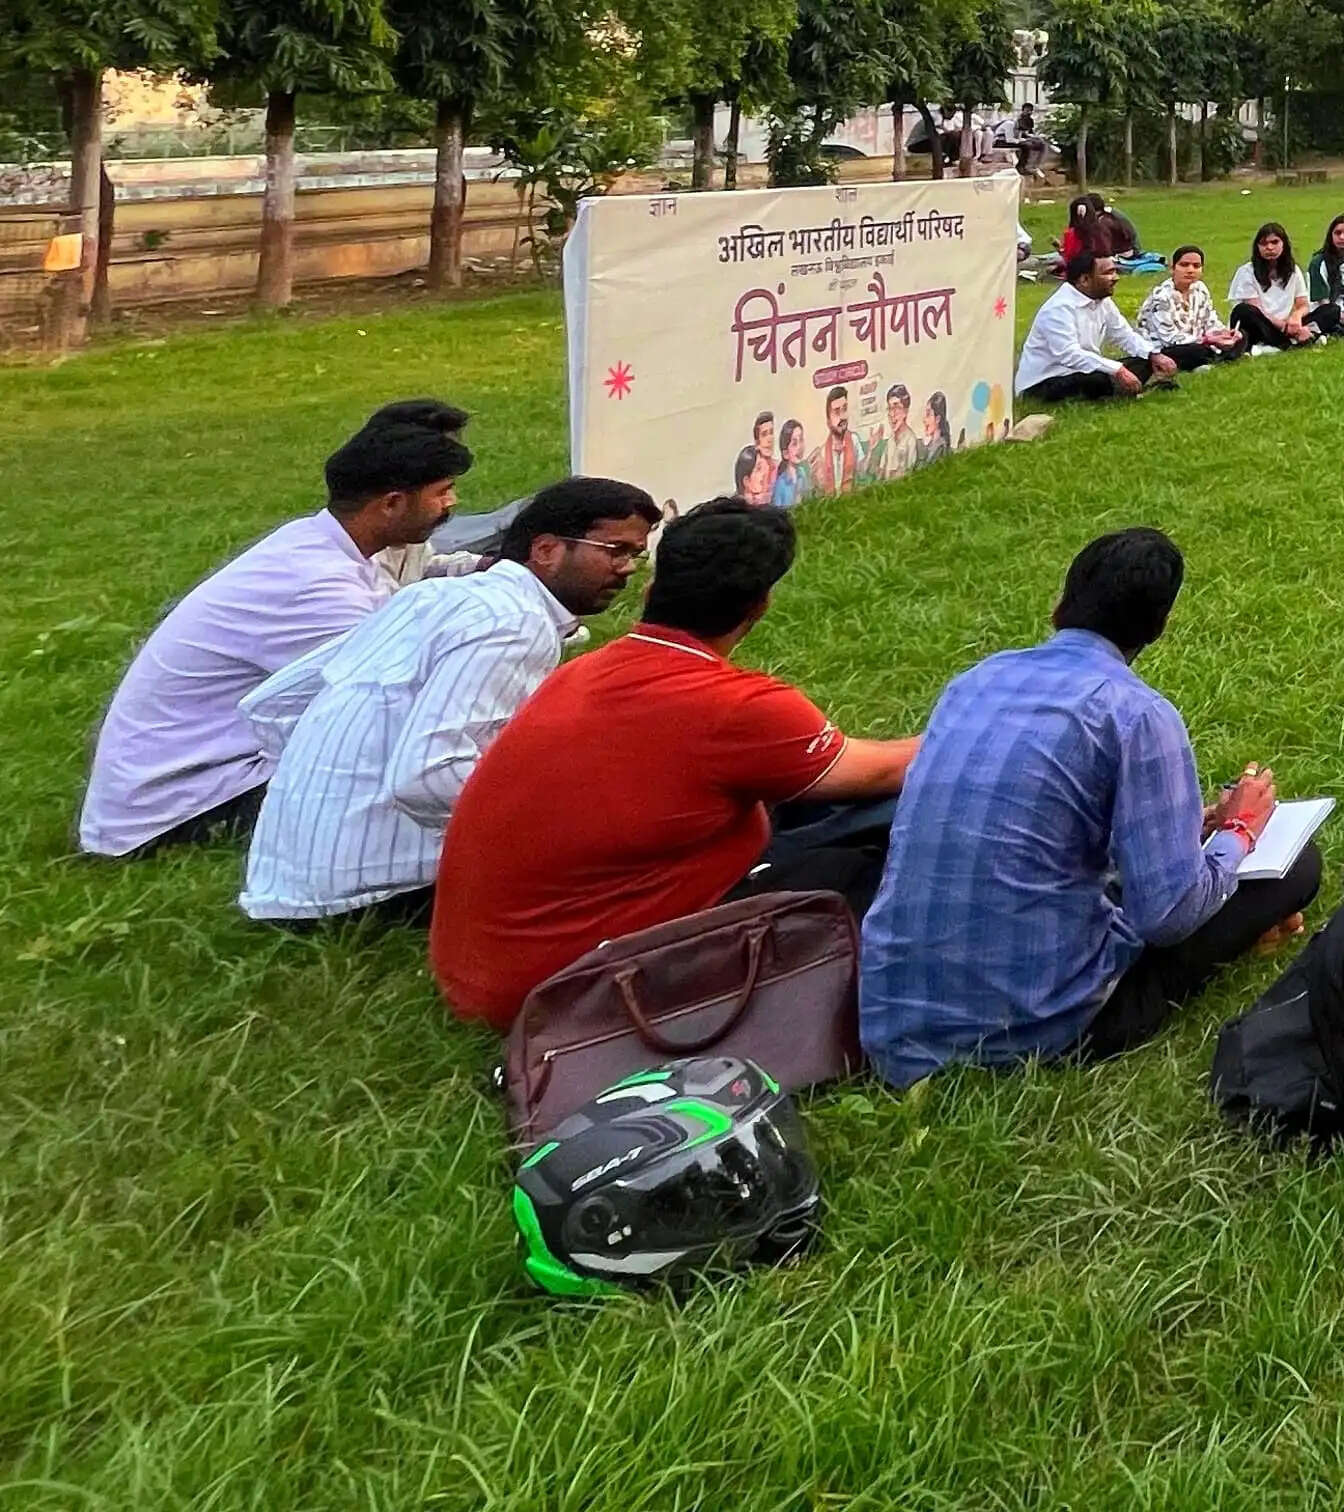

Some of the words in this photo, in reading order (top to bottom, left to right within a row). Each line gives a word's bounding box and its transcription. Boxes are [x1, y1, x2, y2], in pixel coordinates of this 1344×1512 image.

[649, 197, 678, 217] ज्ञान
[718, 224, 784, 263] अखिल
[788, 218, 855, 253] भारतीय
[859, 209, 914, 249] विद्यार्थी
[917, 209, 965, 241] परिषद
[731, 282, 843, 383] चिंतन
[847, 271, 956, 353] चौपाल
